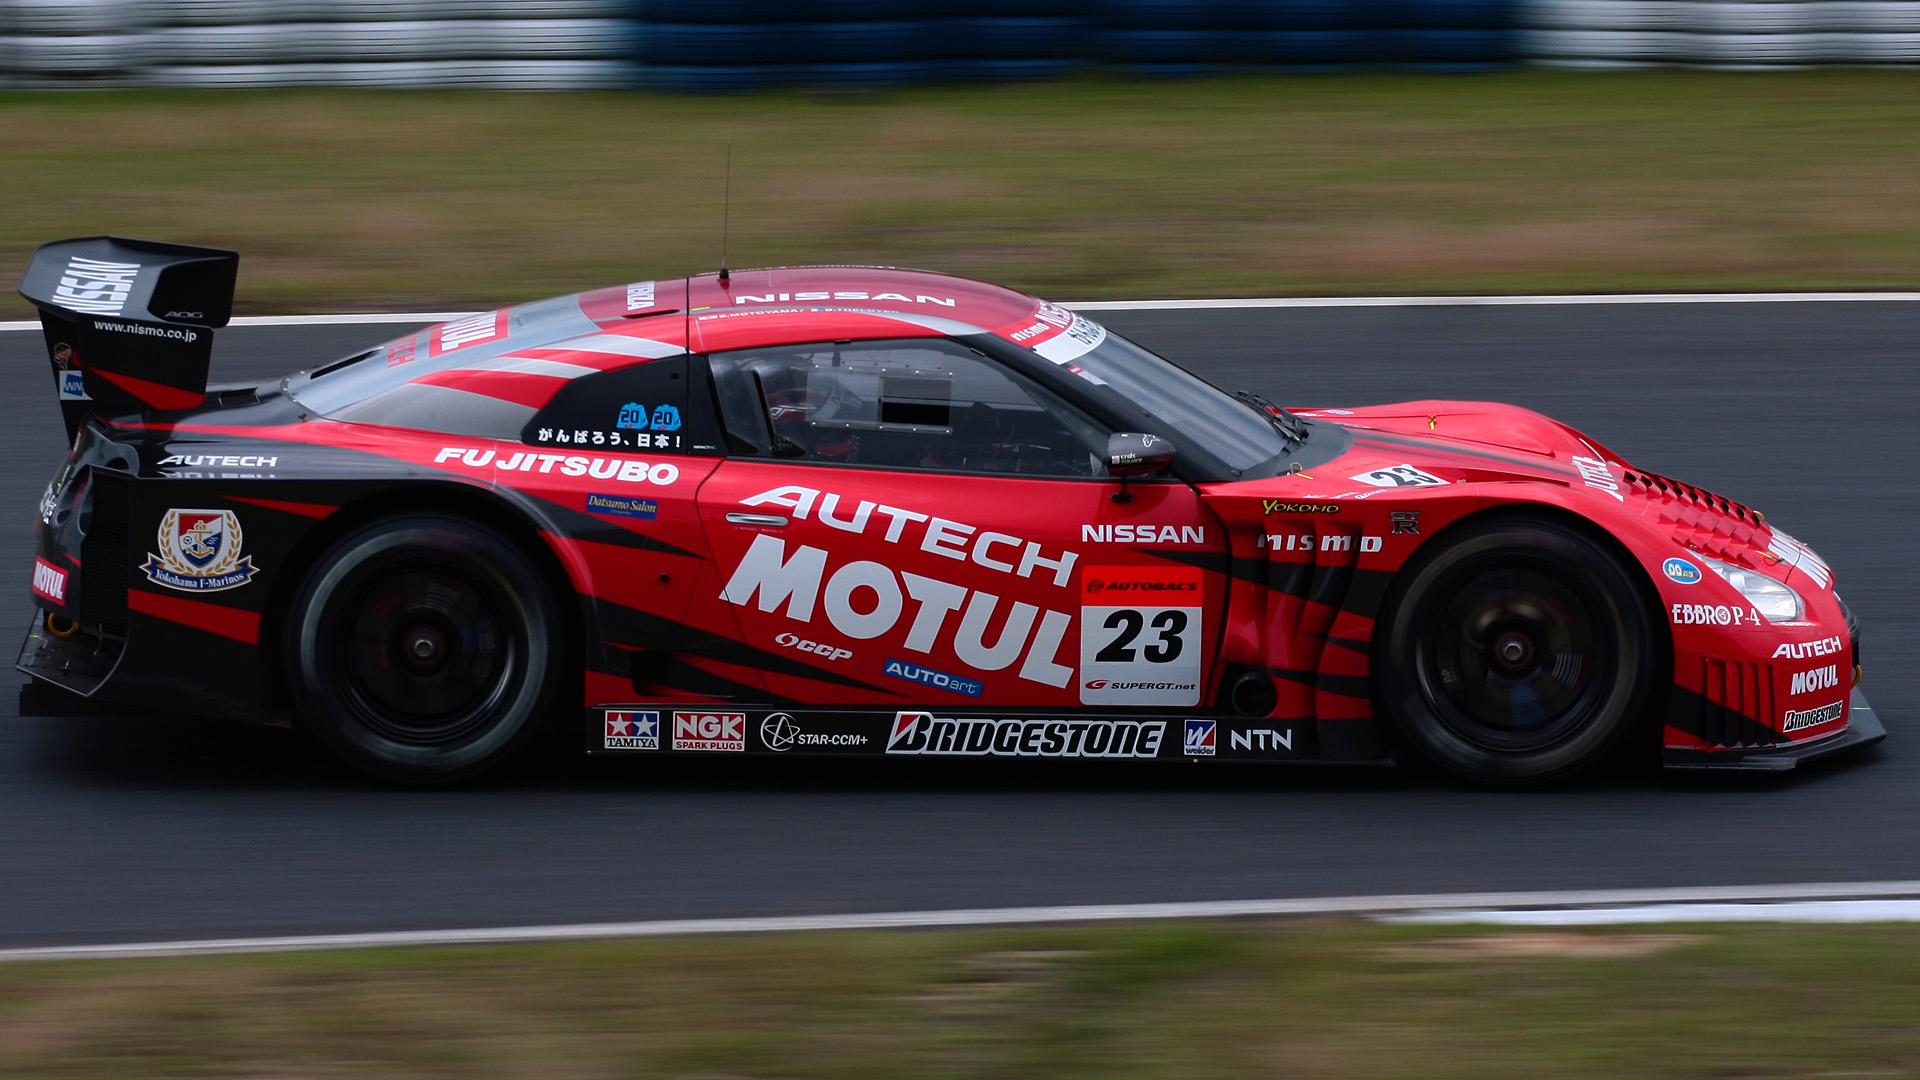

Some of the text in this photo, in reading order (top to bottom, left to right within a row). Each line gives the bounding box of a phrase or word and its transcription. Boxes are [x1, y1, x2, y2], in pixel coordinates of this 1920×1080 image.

[52, 256, 141, 316] NISSAN
[735, 292, 956, 307] NISSAN
[94, 320, 197, 342] www.nismo.co.jp
[620, 410, 639, 423] 20
[653, 411, 672, 425] 20
[538, 428, 681, 449] がんばろう、日本！
[157, 455, 278, 467] AUTECH
[1370, 466, 1438, 487] 23
[630, 500, 657, 513] Salon
[739, 485, 1079, 588] AUTECH
[1081, 524, 1204, 543] NISSAN
[1257, 533, 1383, 552] nismo
[33, 561, 64, 600] MOTUL
[155, 569, 245, 588] Yokohama F-Marinos
[1106, 581, 1197, 591] AUTOBACS
[718, 533, 1075, 689] MOTUL
[1095, 609, 1188, 663] 23
[1772, 635, 1842, 659] AUTECH
[1111, 681, 1195, 691] SUPERGT.net
[1790, 664, 1838, 695] MOTUL
[1783, 700, 1843, 732] BRIDGESTONE
[676, 714, 743, 740] NGK
[886, 711, 1167, 758] BRIDGESTONE
[607, 737, 657, 749] TAMIYA
[676, 741, 743, 751] SPARK PLUGS
[798, 734, 868, 746] STAR-CCM+
[1231, 728, 1292, 751] NTN
